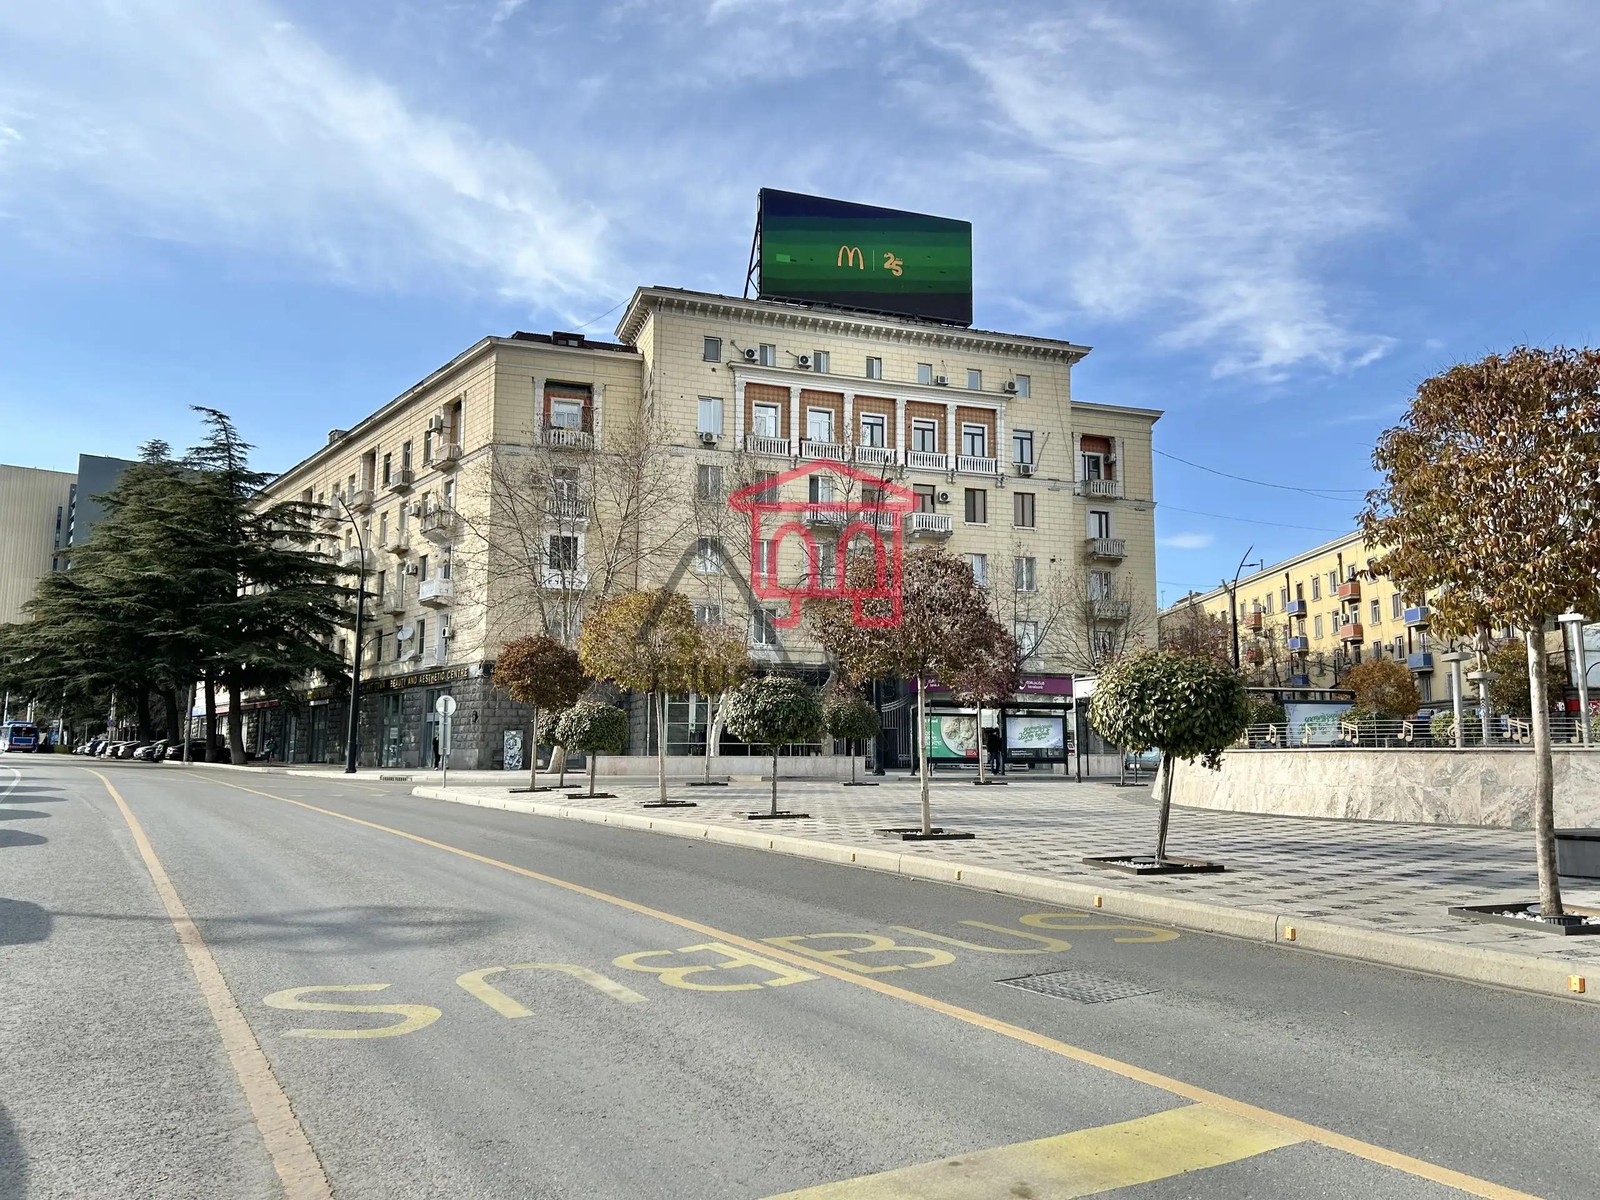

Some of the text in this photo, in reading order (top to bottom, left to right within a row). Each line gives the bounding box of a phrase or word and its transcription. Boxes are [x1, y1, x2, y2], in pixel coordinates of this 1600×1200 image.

[883, 252, 903, 277] 25
[390, 678, 406, 688] BEAUTY
[408, 676, 418, 685] AND
[419, 671, 445, 683] AESTHETIC
[446, 667, 468, 680] CENTRE
[759, 911, 1180, 974] BUS
[262, 942, 821, 1039] BUS
